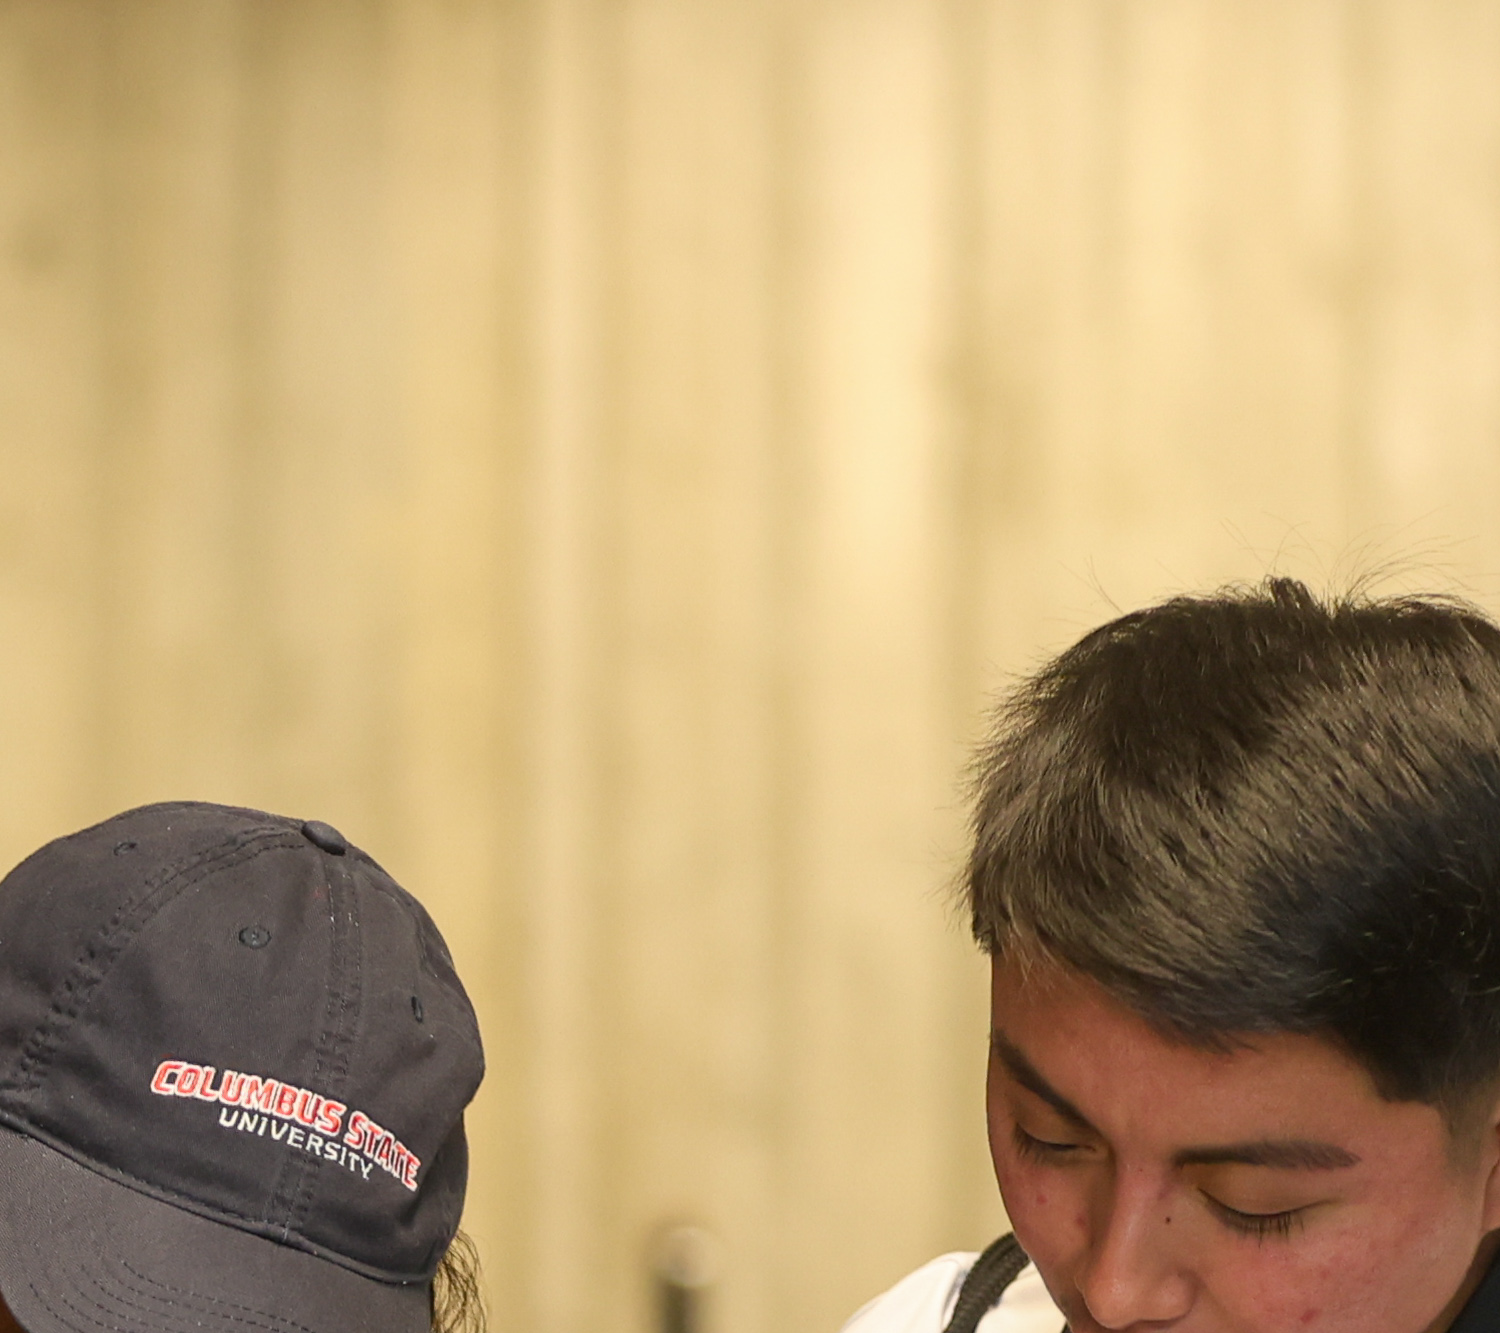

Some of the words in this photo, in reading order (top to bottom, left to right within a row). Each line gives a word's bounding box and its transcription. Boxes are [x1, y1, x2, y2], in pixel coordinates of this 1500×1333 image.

[151, 1060, 347, 1136] COLUMBUS
[344, 1111, 422, 1192] STATE
[218, 1107, 373, 1180] UNIVERSITY
